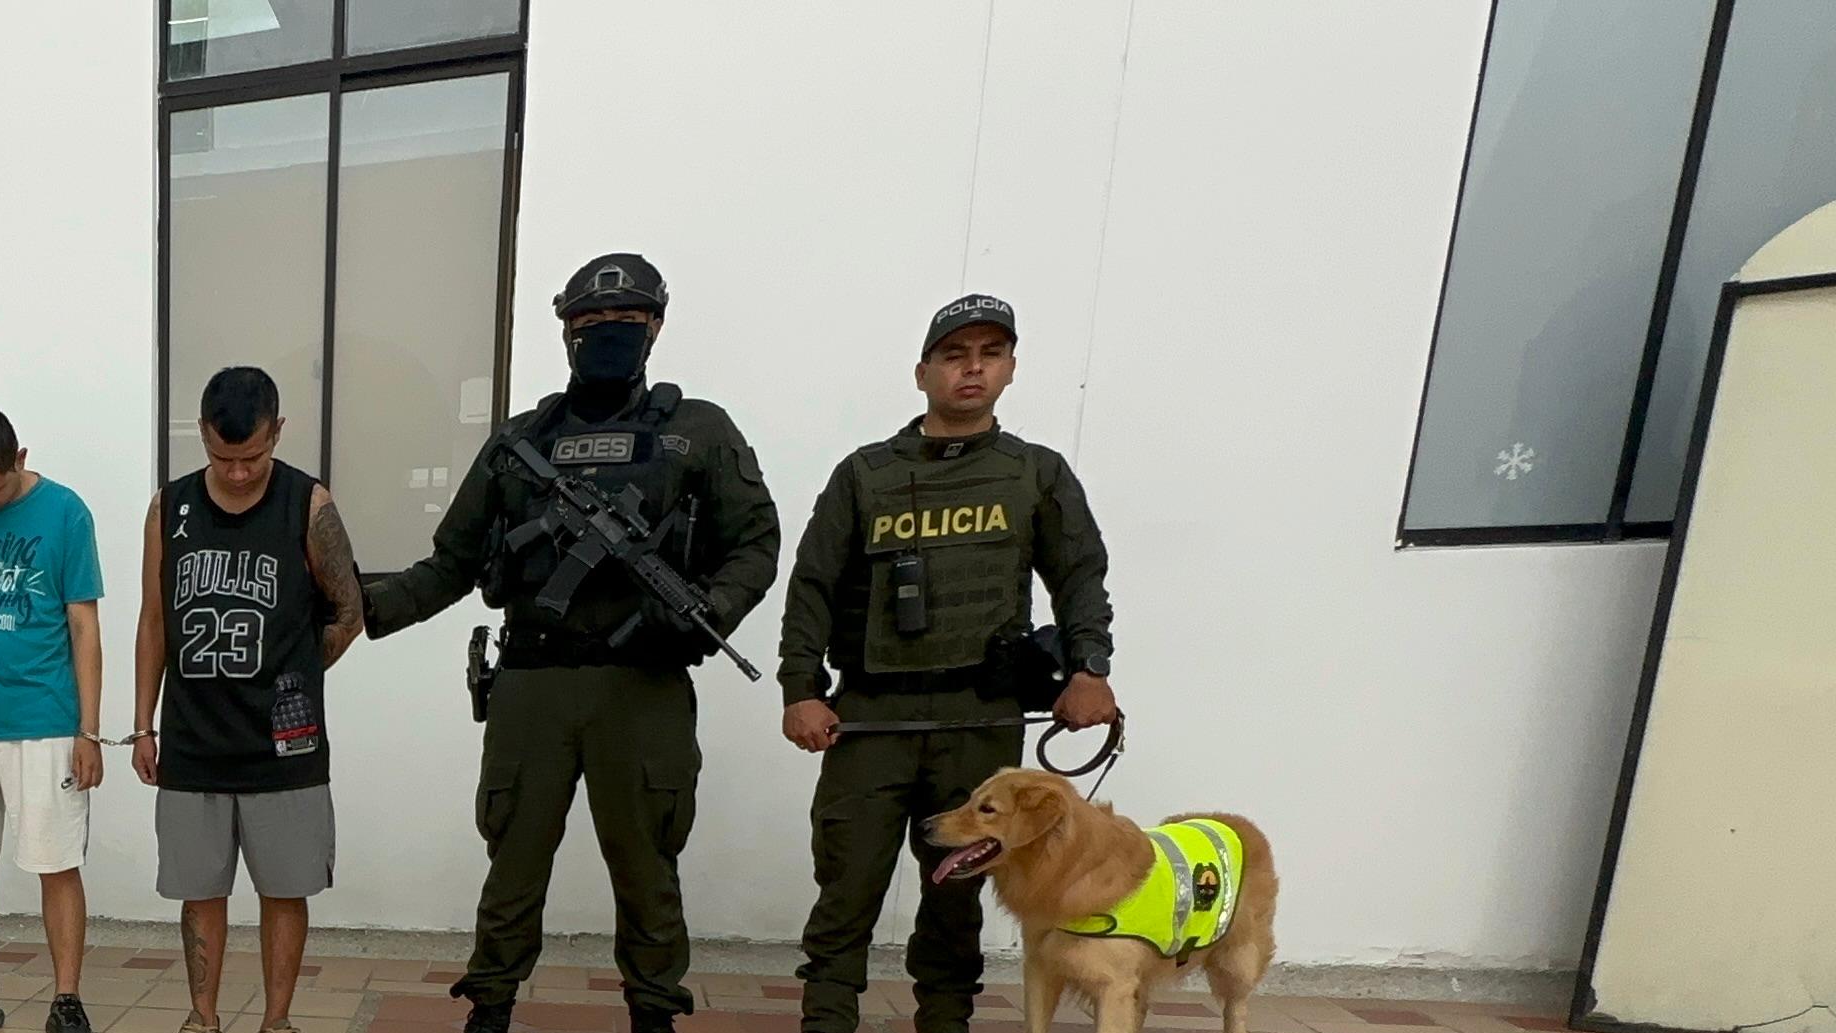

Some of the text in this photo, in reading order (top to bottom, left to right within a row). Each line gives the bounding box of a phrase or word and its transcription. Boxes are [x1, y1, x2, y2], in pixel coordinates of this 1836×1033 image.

[556, 437, 628, 459] GOES
[872, 504, 1008, 543] POLICIA
[174, 550, 278, 611] BULLS
[179, 607, 264, 678] 23
